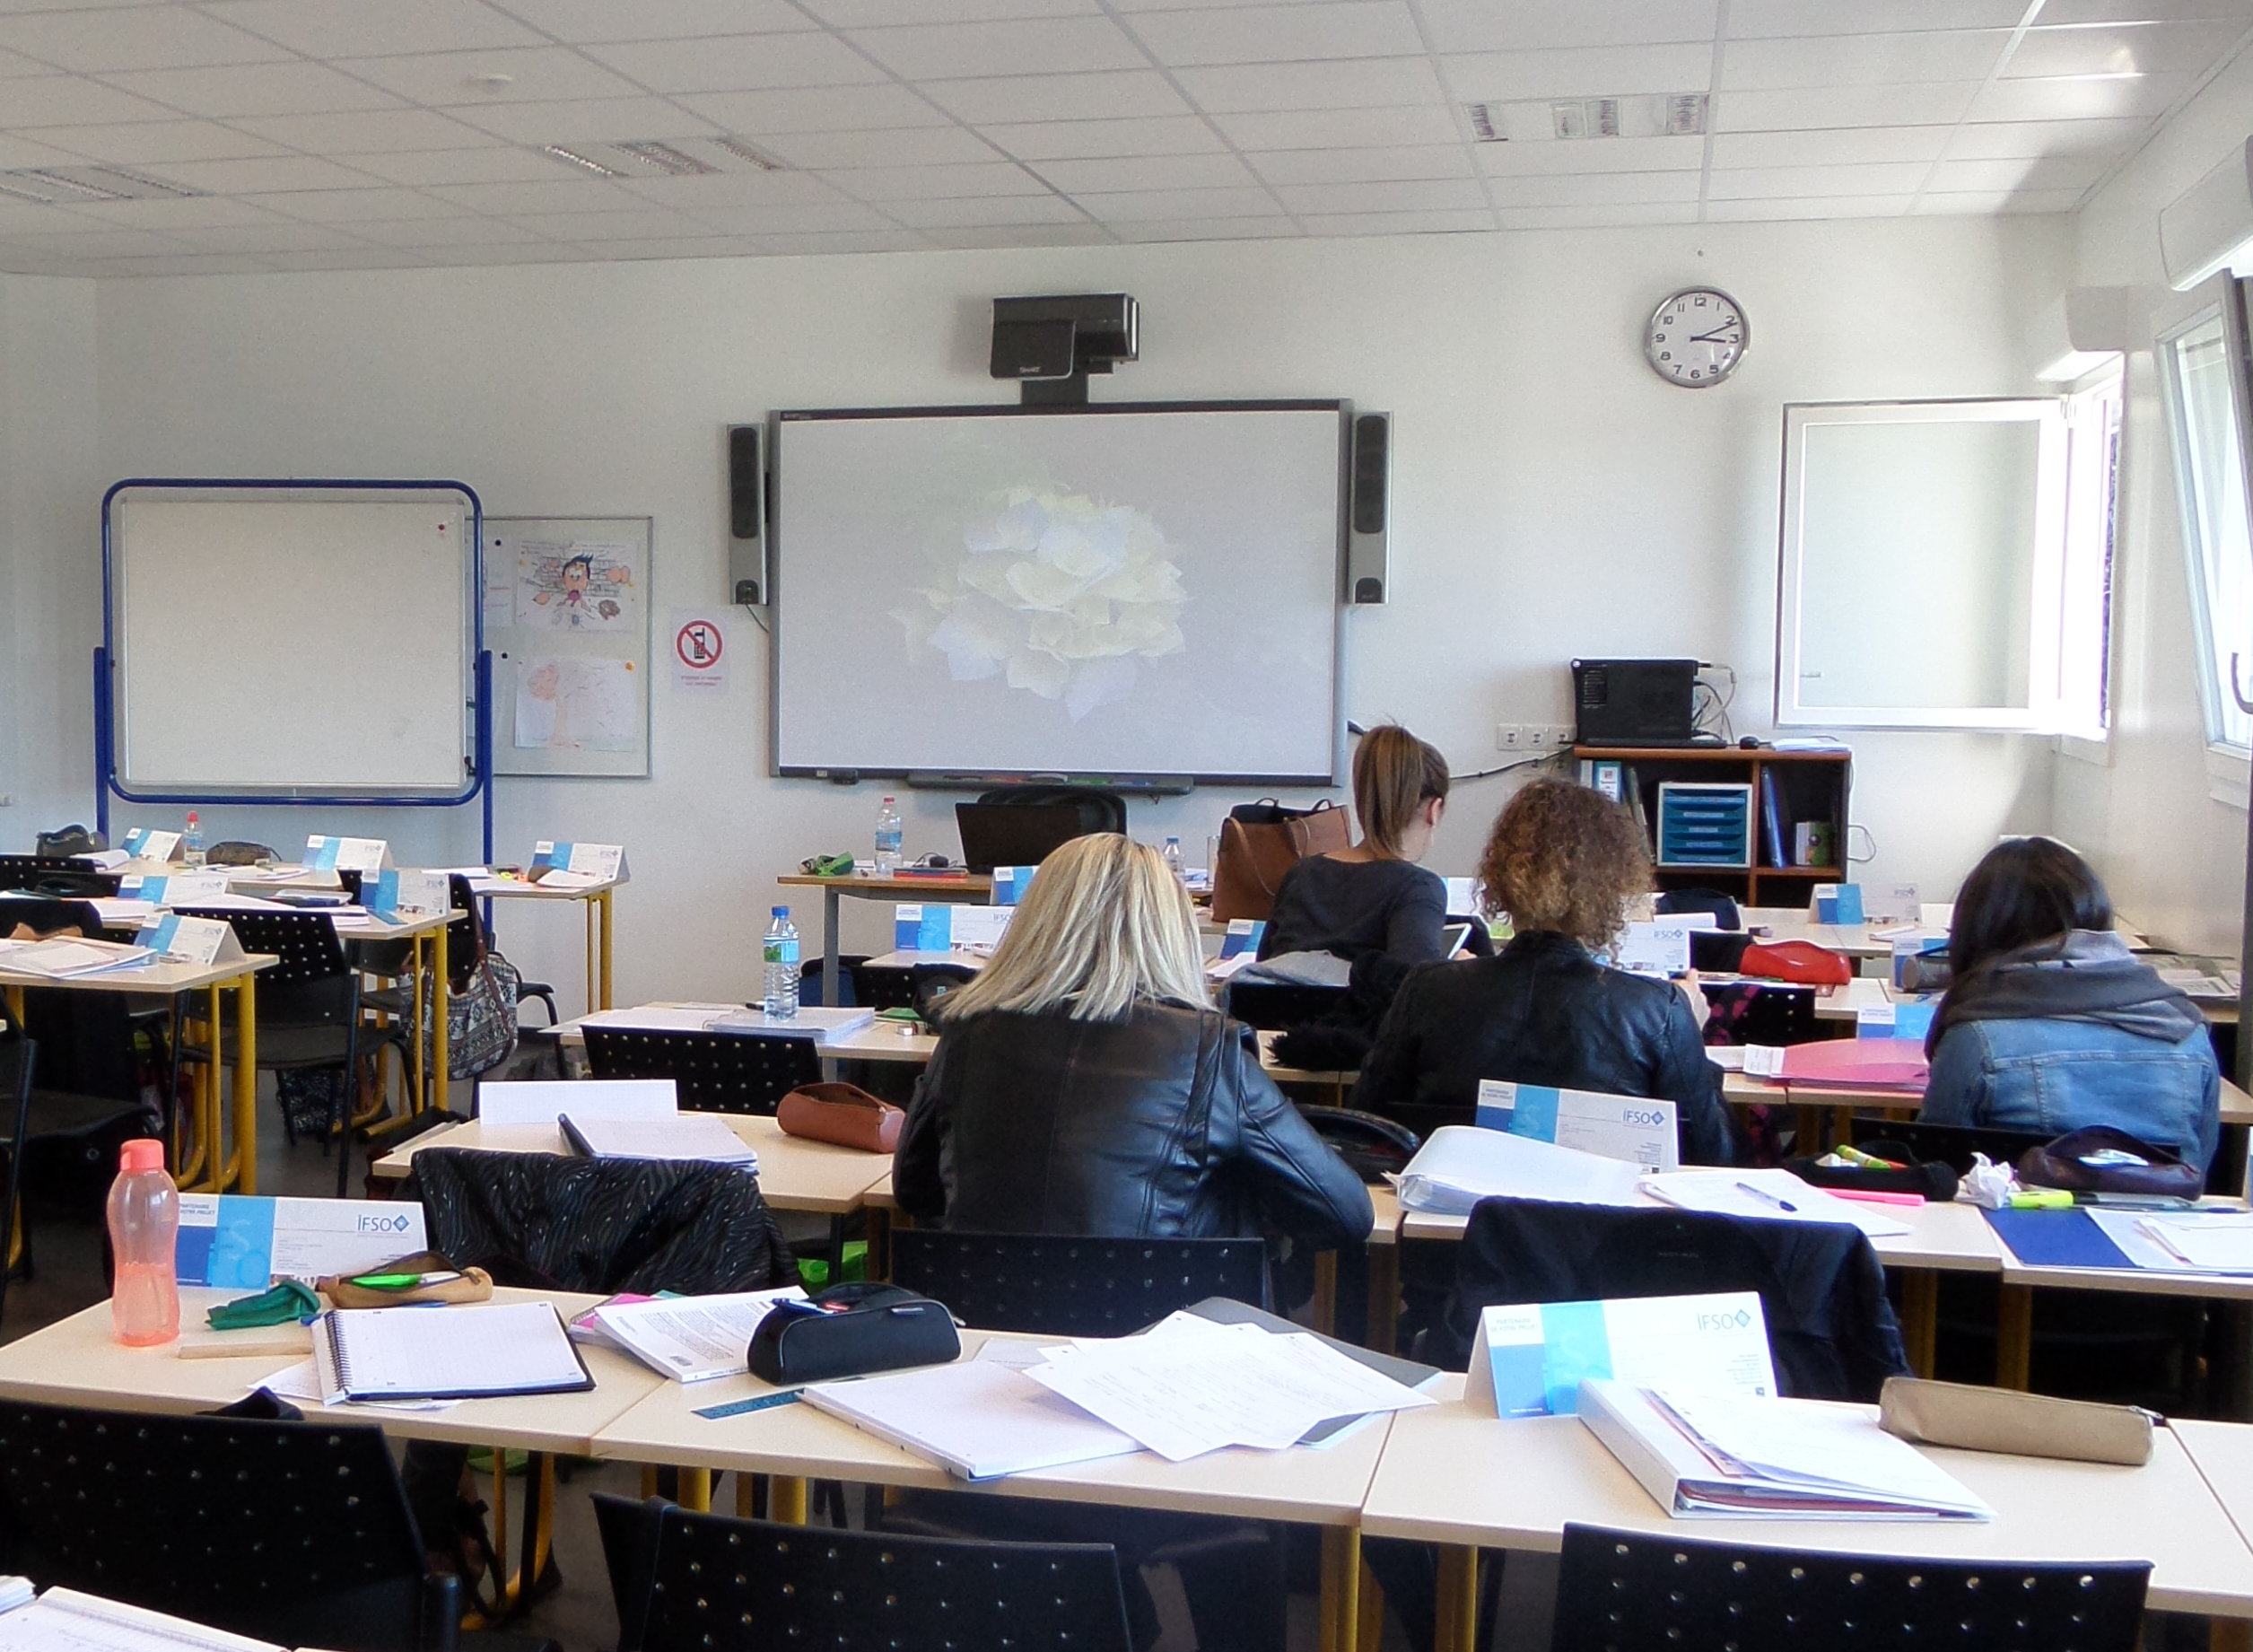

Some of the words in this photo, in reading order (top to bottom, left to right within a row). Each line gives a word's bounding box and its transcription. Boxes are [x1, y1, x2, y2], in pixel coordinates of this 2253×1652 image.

[1677, 302, 1685, 312] 11
[1694, 297, 1707, 307] 12
[1663, 316, 1673, 325] 10
[1725, 315, 1735, 325] 2
[1655, 333, 1666, 343] 9
[1729, 334, 1740, 344] 3
[1660, 351, 1672, 361] 8
[1673, 364, 1683, 375] 7
[1690, 369, 1700, 379] 6
[1708, 364, 1720, 374] 5
